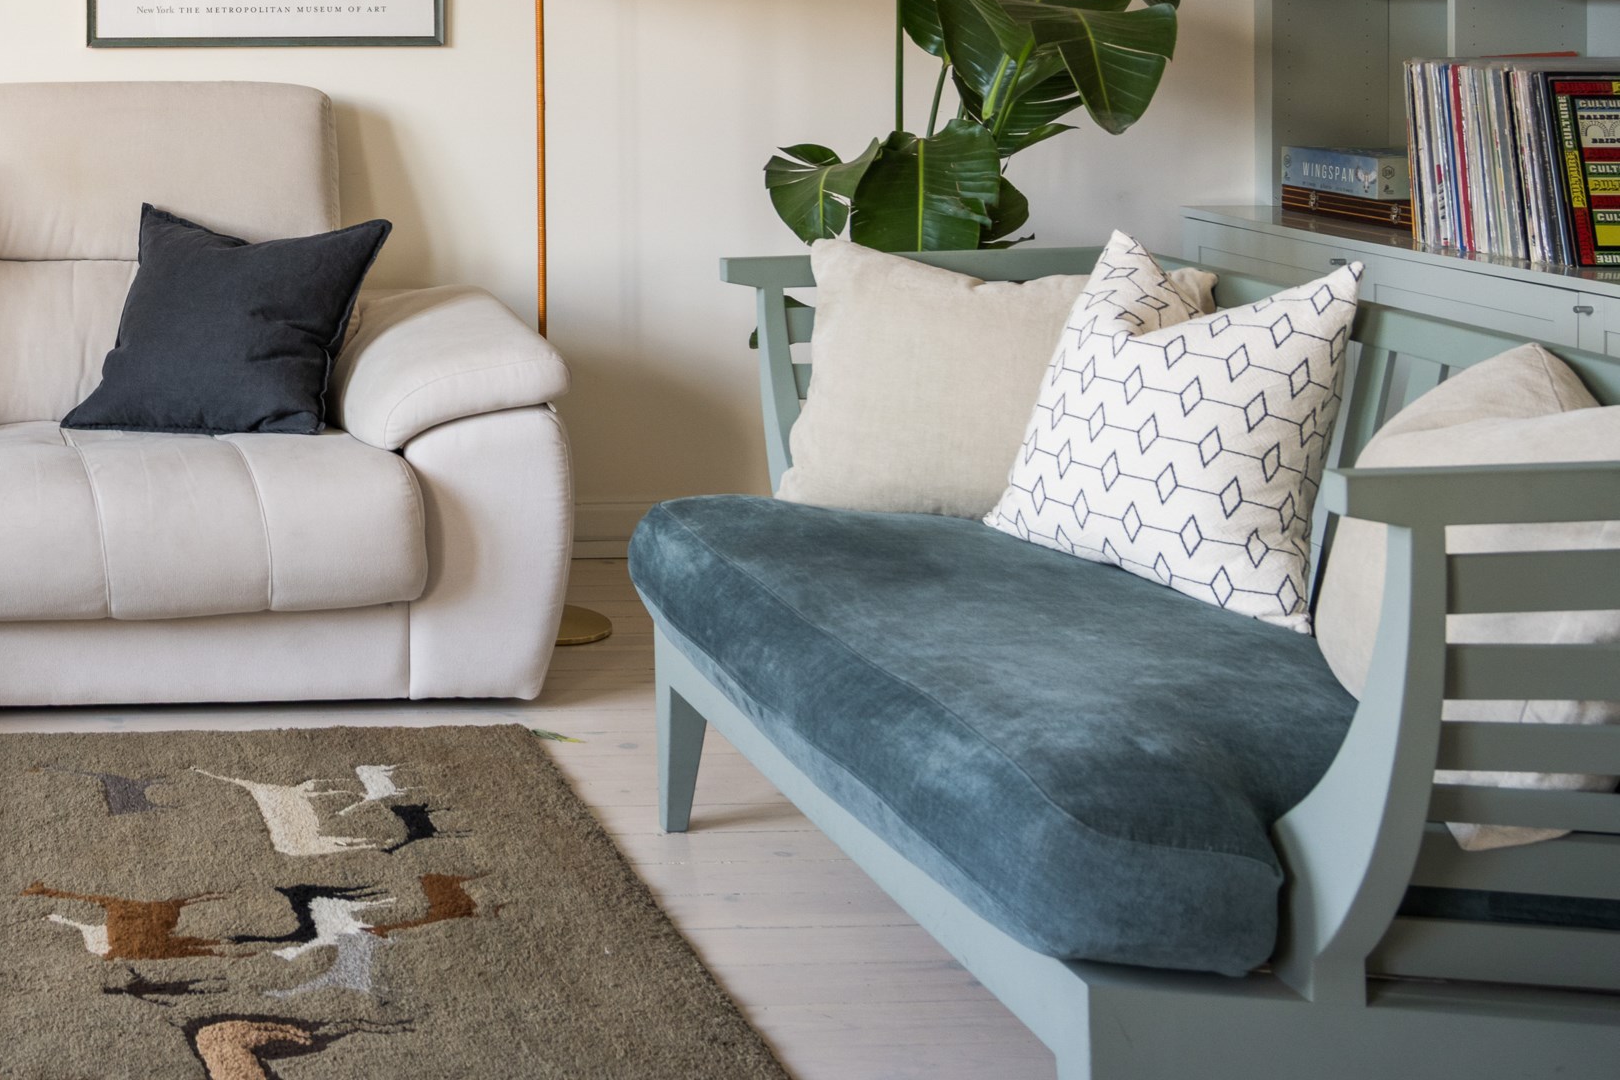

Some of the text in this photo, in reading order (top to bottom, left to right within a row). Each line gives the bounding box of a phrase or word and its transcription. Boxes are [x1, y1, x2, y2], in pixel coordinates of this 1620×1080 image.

[137, 6, 154, 15] New
[156, 6, 174, 15] York
[297, 6, 342, 14] MUSEUM
[1557, 95, 1574, 149] CULTURE
[1302, 162, 1354, 183] WINGSPAN
[1565, 150, 1586, 206] CULTURE
